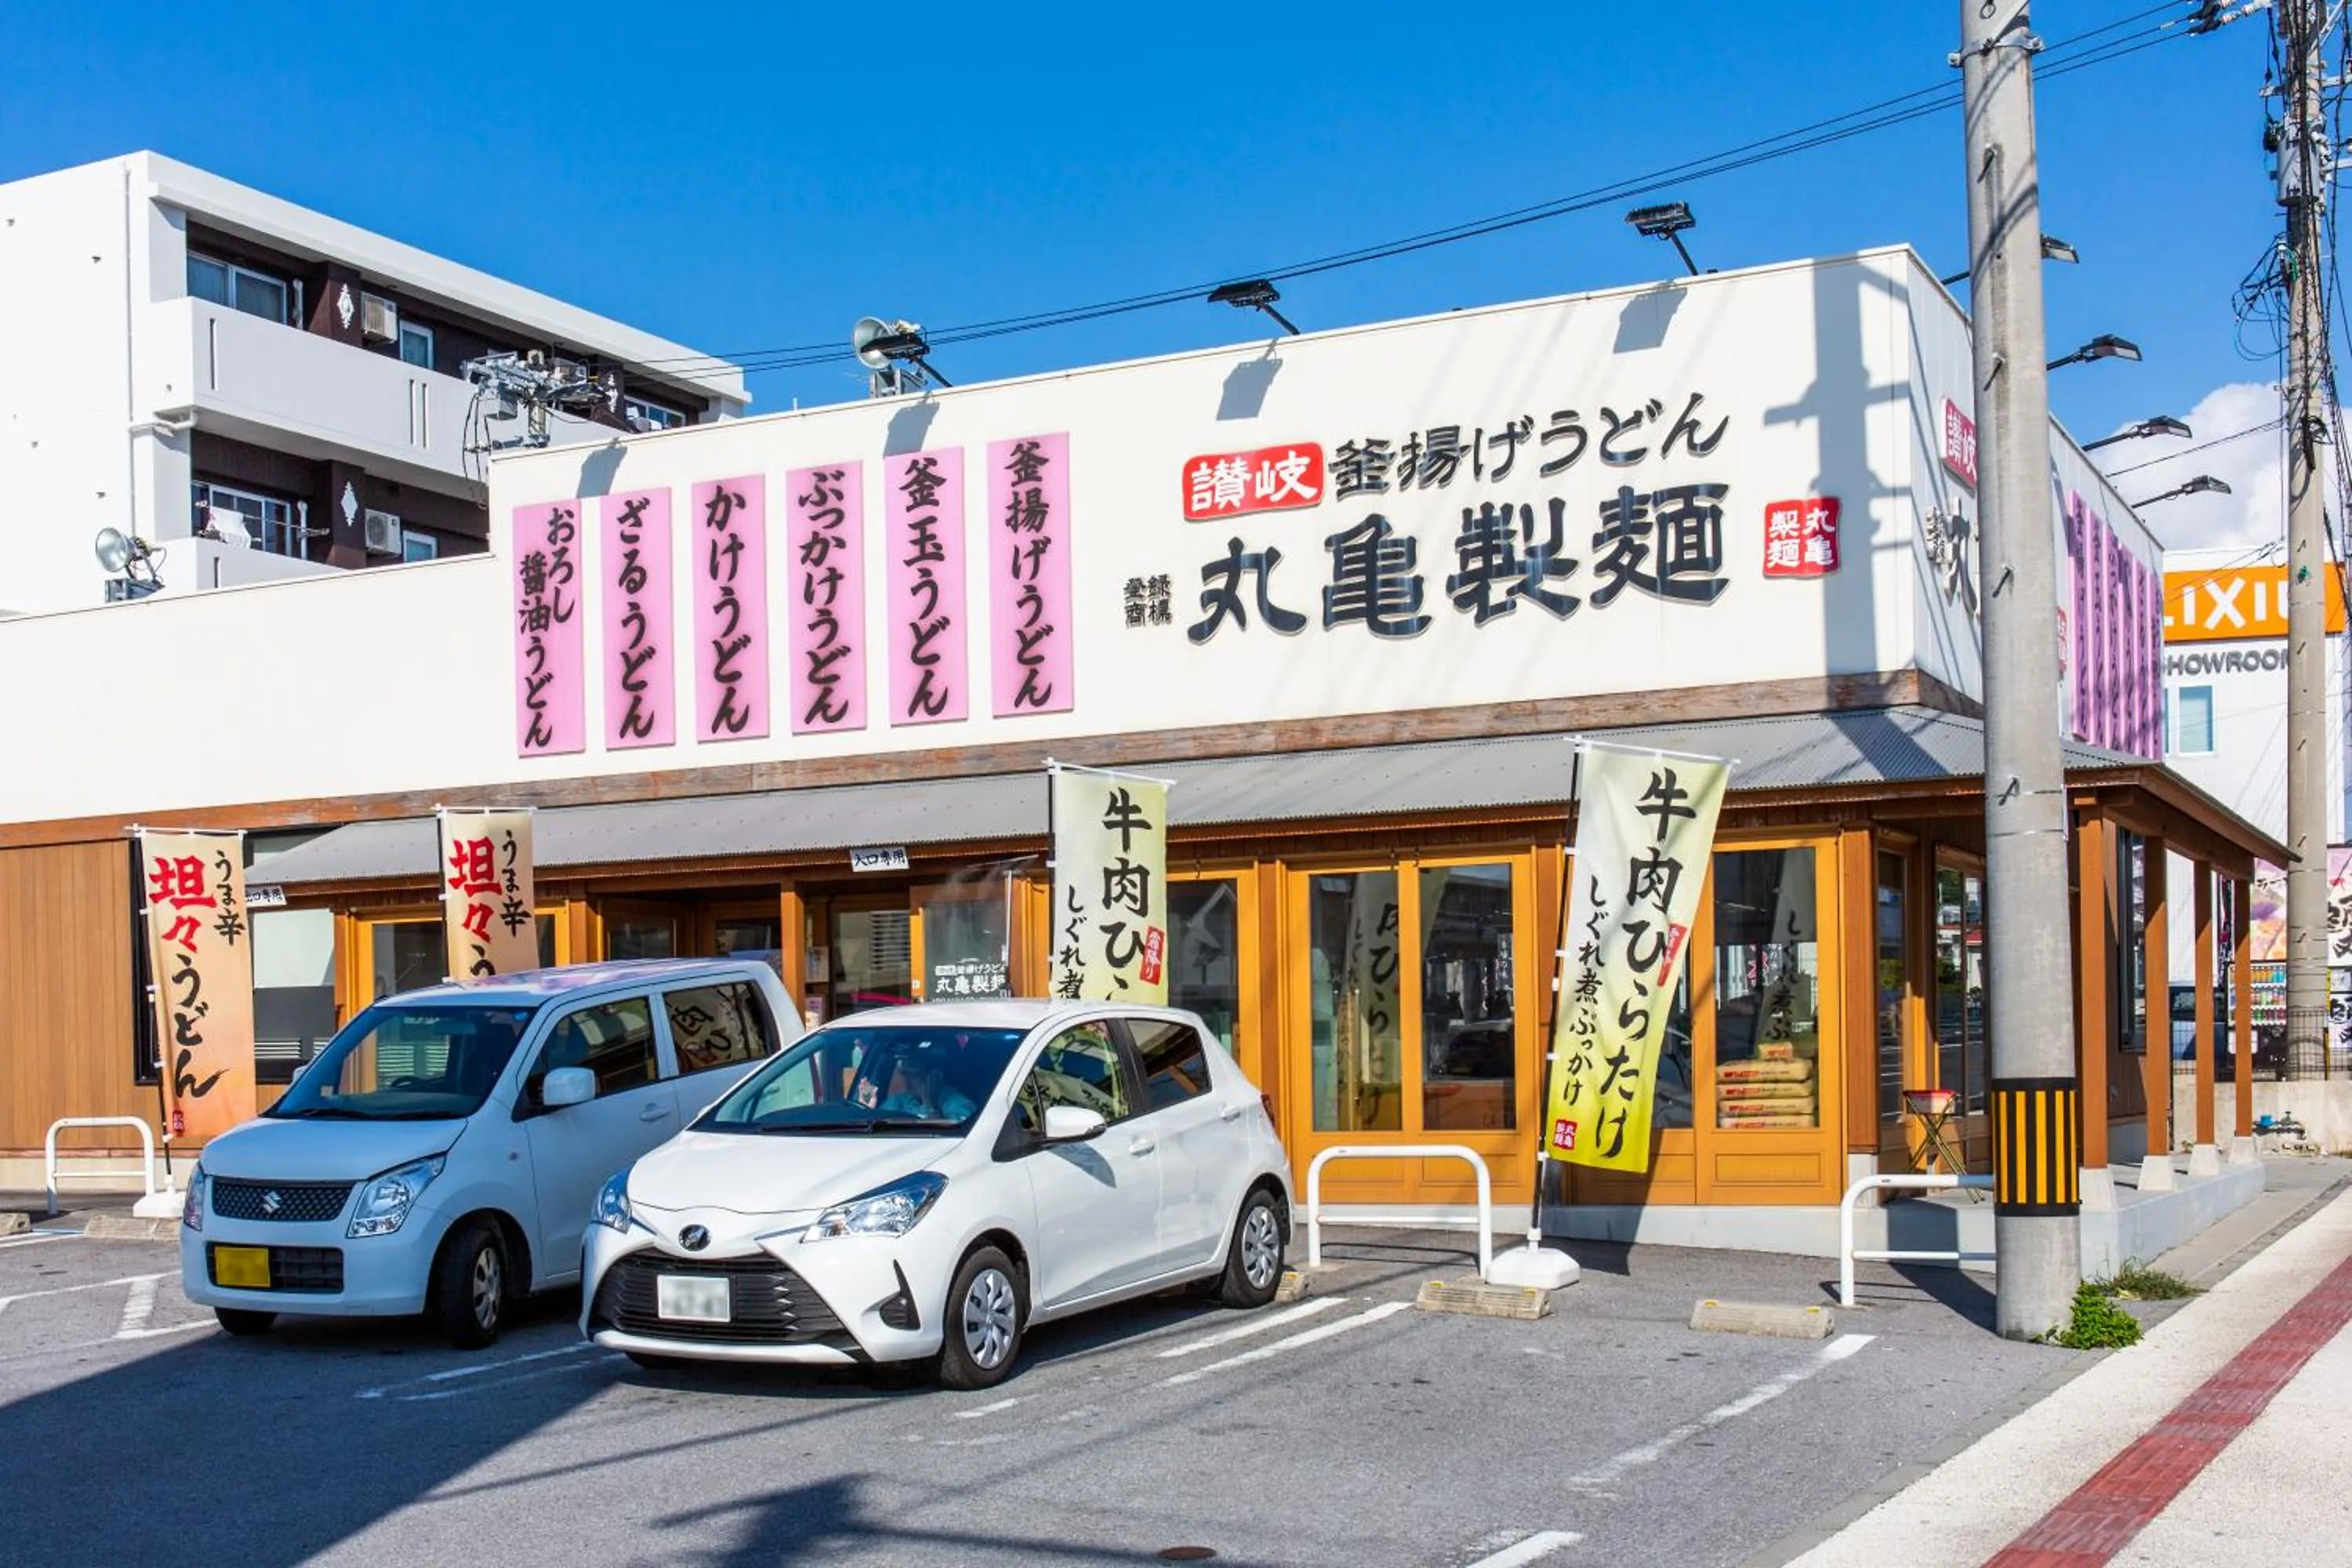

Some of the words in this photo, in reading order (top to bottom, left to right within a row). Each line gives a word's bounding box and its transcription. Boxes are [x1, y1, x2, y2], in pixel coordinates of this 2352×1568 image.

[1192, 450, 1318, 512] 讃岐
[1328, 392, 1729, 501] 釜揚げうどん
[1767, 509, 1800, 568] 製麺
[1803, 507, 1835, 565] 丸亀
[518, 551, 554, 749] 醤油うどん
[547, 508, 575, 623] おろし
[617, 497, 655, 739] ざるうどん
[705, 485, 751, 734] かけうどん
[798, 470, 850, 725] ぶっかけうどん
[899, 457, 949, 717] 釜玉うどん
[1005, 441, 1050, 708] 釜揚げうどん
[1187, 484, 1730, 644] 丸亀製麺
[212, 850, 245, 946] うま辛
[500, 829, 532, 938] うま辛
[855, 849, 906, 866] 入口専用
[1099, 787, 1152, 1001] 牛肉ひ
[149, 855, 230, 1098] 坦々うどん
[1595, 767, 1696, 1158] 牛肉ひらたけ
